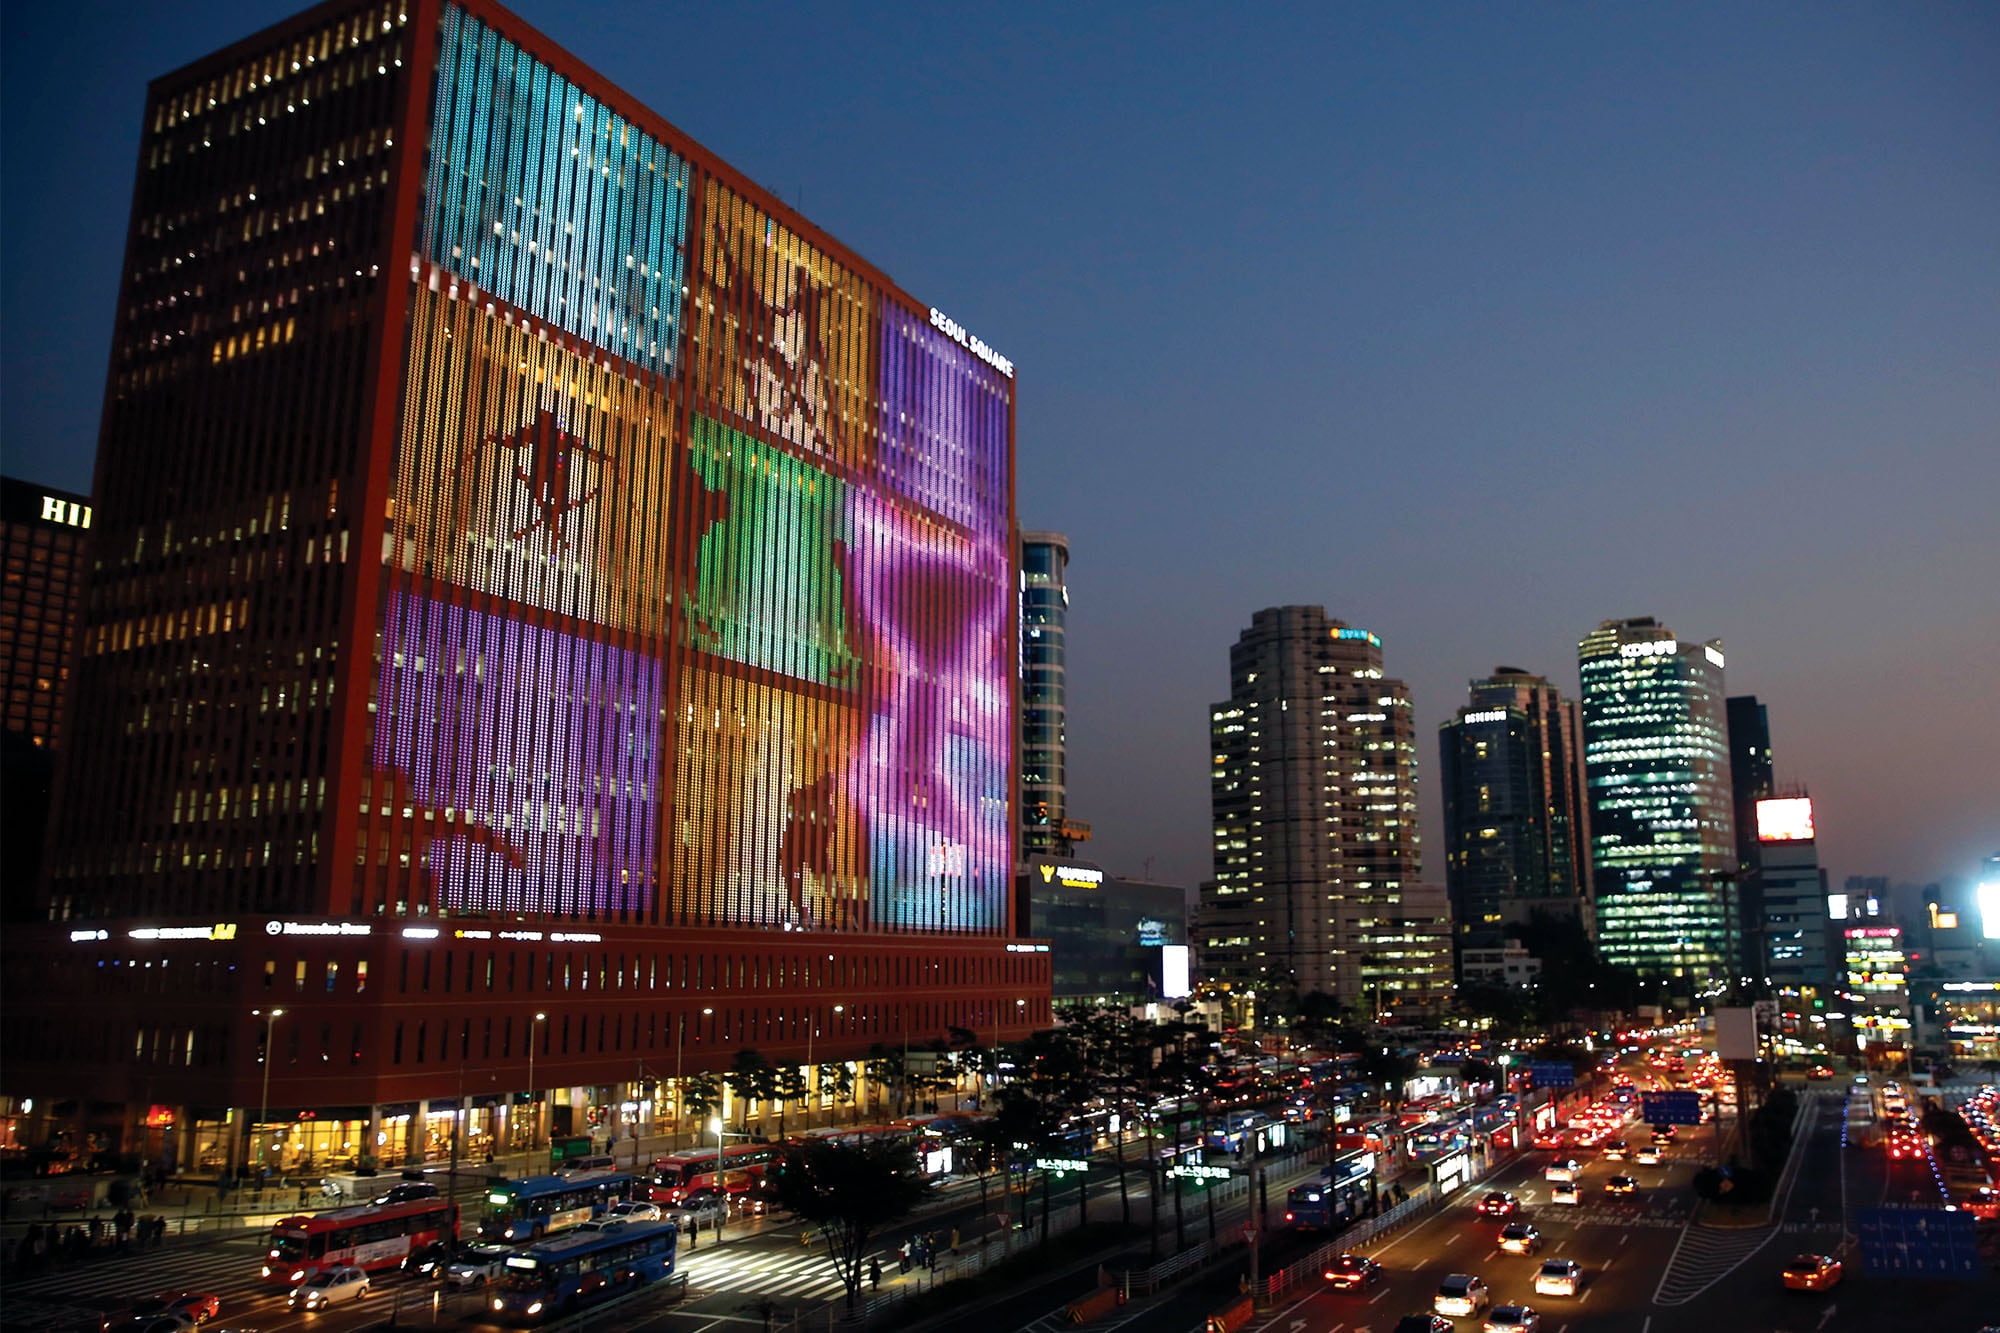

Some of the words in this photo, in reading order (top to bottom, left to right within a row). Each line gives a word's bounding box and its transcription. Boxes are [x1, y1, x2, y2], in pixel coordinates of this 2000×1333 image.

[929, 307, 969, 348] SEOUL
[969, 335, 1014, 379] SQUARE
[1257, 1132, 1266, 1153] 6
